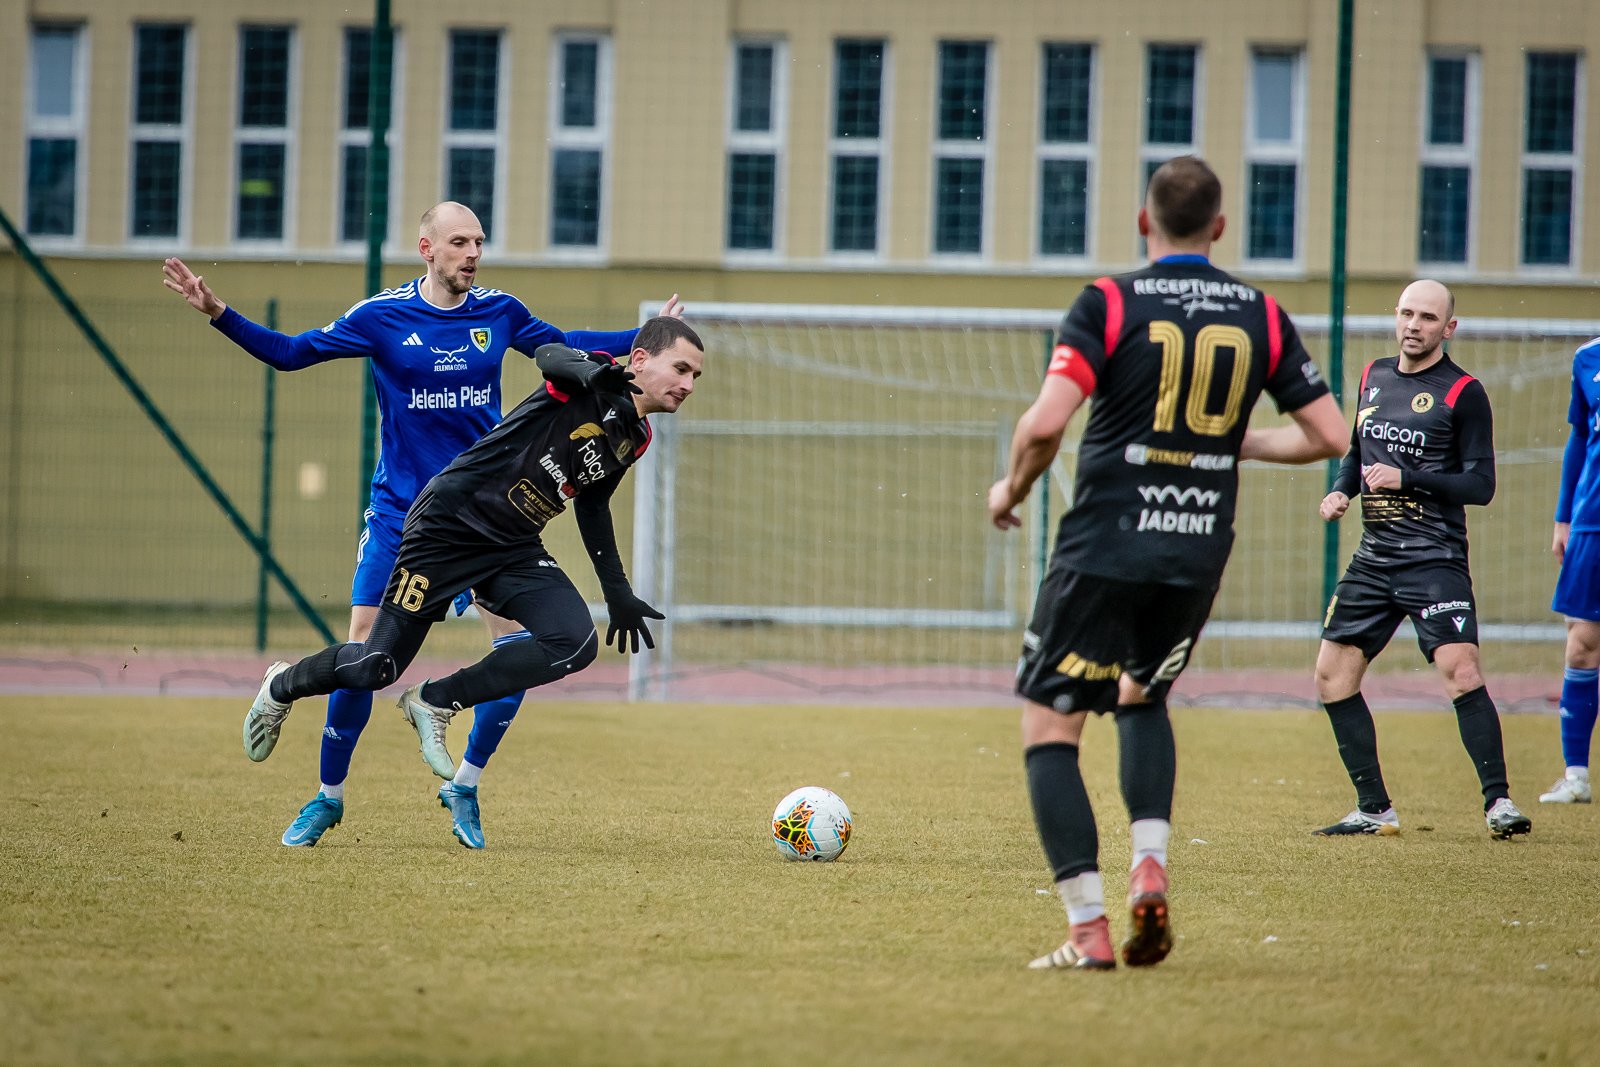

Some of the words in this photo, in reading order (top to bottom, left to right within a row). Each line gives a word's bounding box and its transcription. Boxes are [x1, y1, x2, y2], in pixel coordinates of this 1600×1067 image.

[1149, 320, 1252, 437] 10
[408, 387, 457, 409] Jelenia
[460, 383, 491, 408] Plast
[1362, 419, 1426, 447] Falcon
[578, 438, 605, 481] Falco
[1387, 443, 1424, 457] group
[1137, 508, 1217, 535] JADENT
[392, 567, 429, 613] 16
[1437, 600, 1470, 611] Partner
